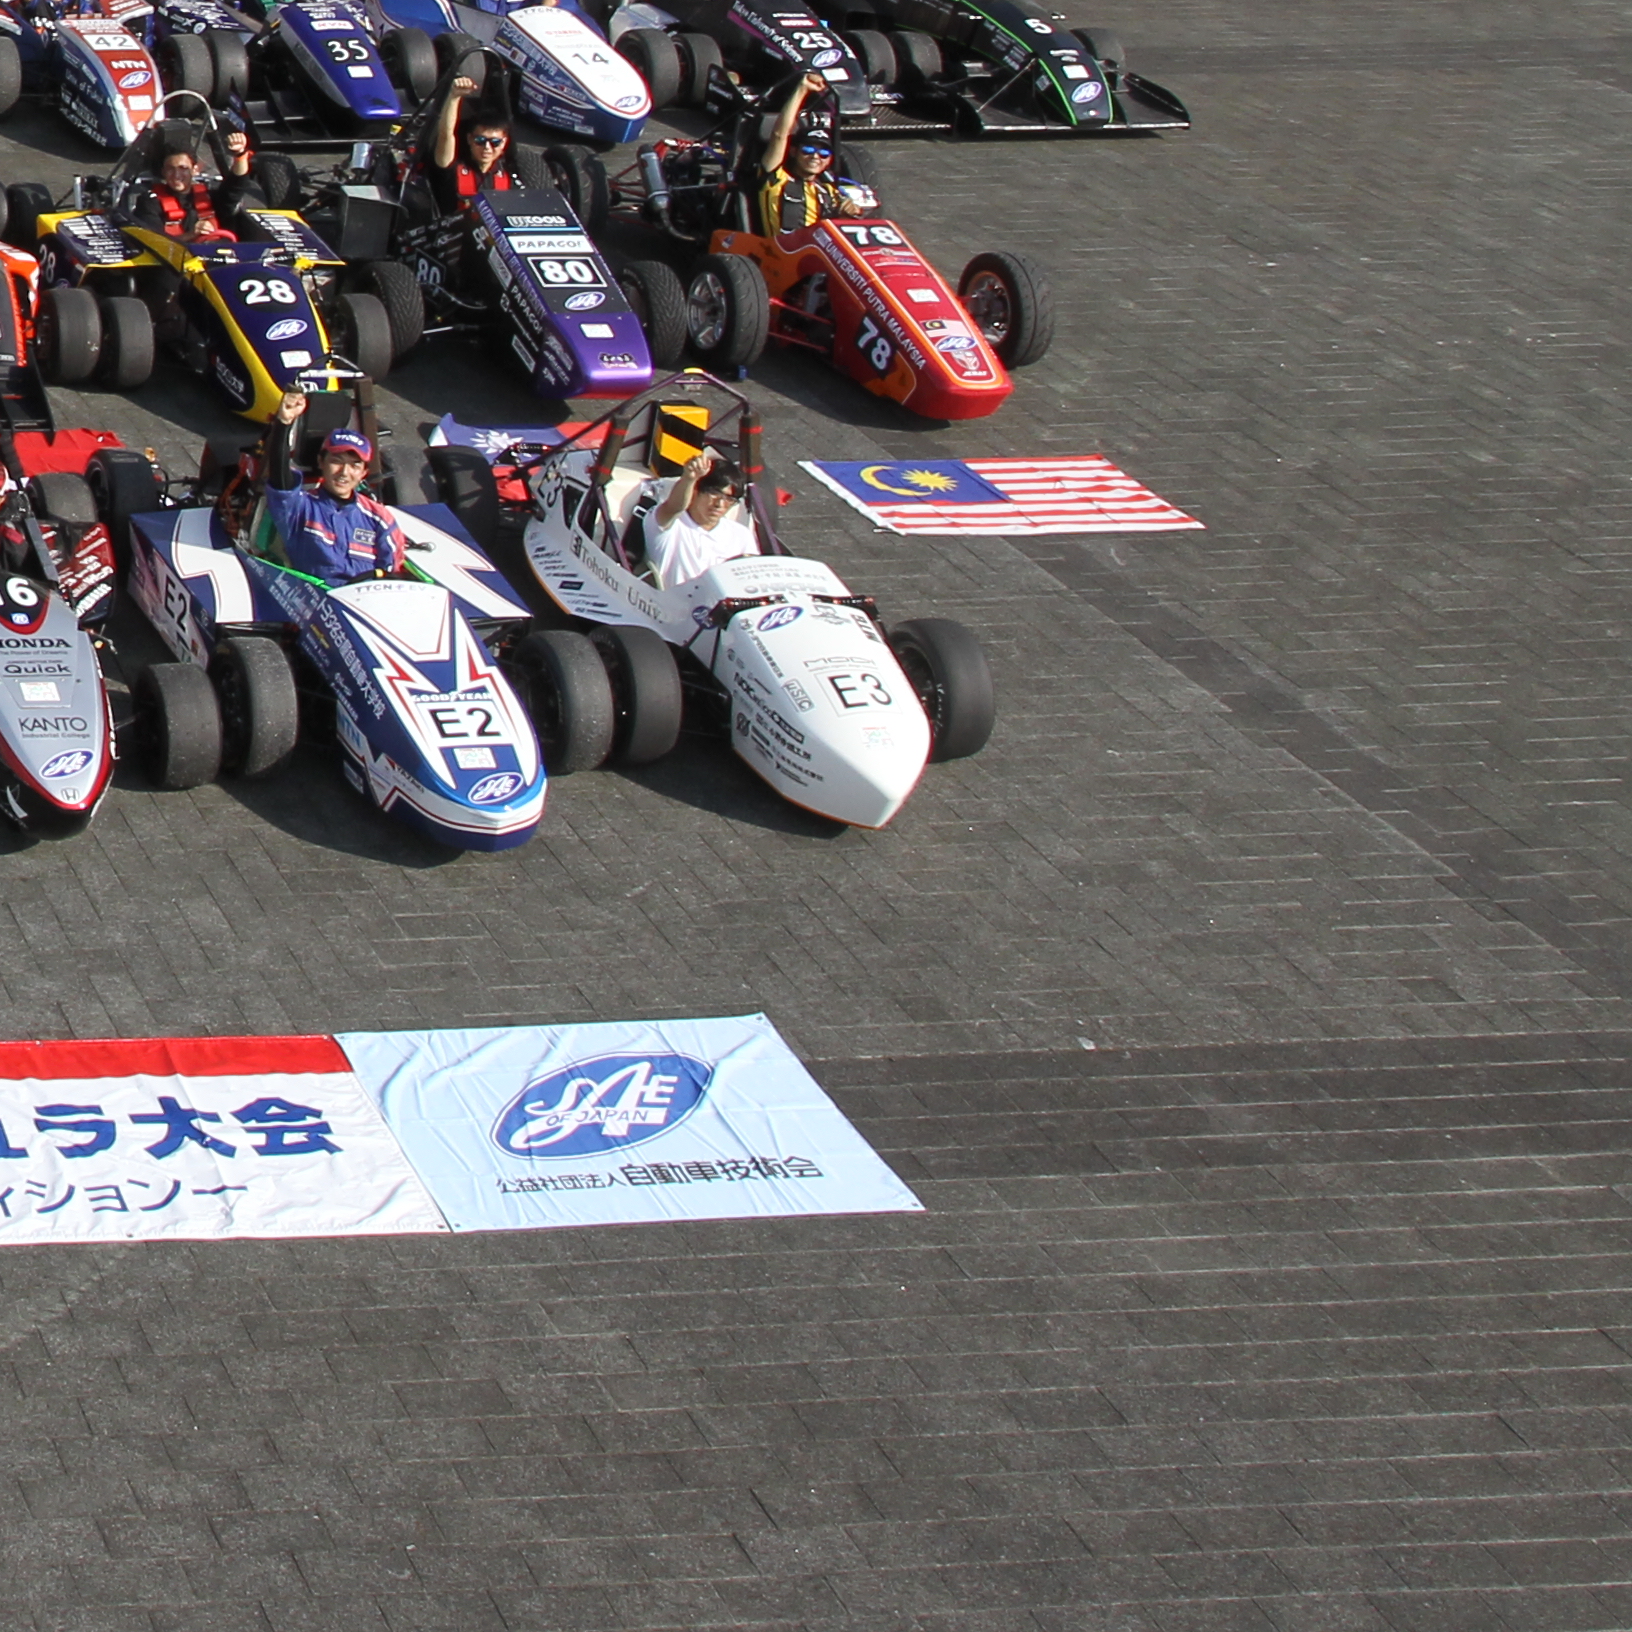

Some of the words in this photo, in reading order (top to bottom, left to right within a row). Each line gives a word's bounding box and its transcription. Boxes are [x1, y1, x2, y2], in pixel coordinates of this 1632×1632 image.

[1024, 18, 1053, 35] 5
[94, 35, 136, 48] 42
[327, 39, 370, 62] 35
[792, 31, 834, 49] 25
[110, 61, 147, 70] NTN
[572, 50, 610, 69] 14
[516, 239, 582, 250] PAPAGO!
[840, 225, 903, 246] 78
[39, 244, 56, 269] 28
[538, 260, 595, 284] 80
[239, 278, 298, 306] 28
[826, 241, 867, 291] UNIVERSITI
[862, 286, 891, 327] PUTRA
[886, 318, 927, 370] MALAYSIA
[859, 318, 892, 371] 78
[580, 547, 619, 594] Tohoku
[625, 587, 665, 625] Univ.
[164, 574, 188, 632] E2
[3, 664, 72, 675] Quick
[317, 596, 388, 721] トヨタ名古屋自動車大学校
[827, 672, 893, 709] E3
[18, 716, 89, 733] KANTO
[433, 707, 503, 739] E2
[22, 731, 59, 740] Industrial
[544, 1109, 578, 1128] OF
[578, 1108, 650, 1126] JAPAN
[495, 1155, 825, 1195] 公益社団法人自動車技術会
